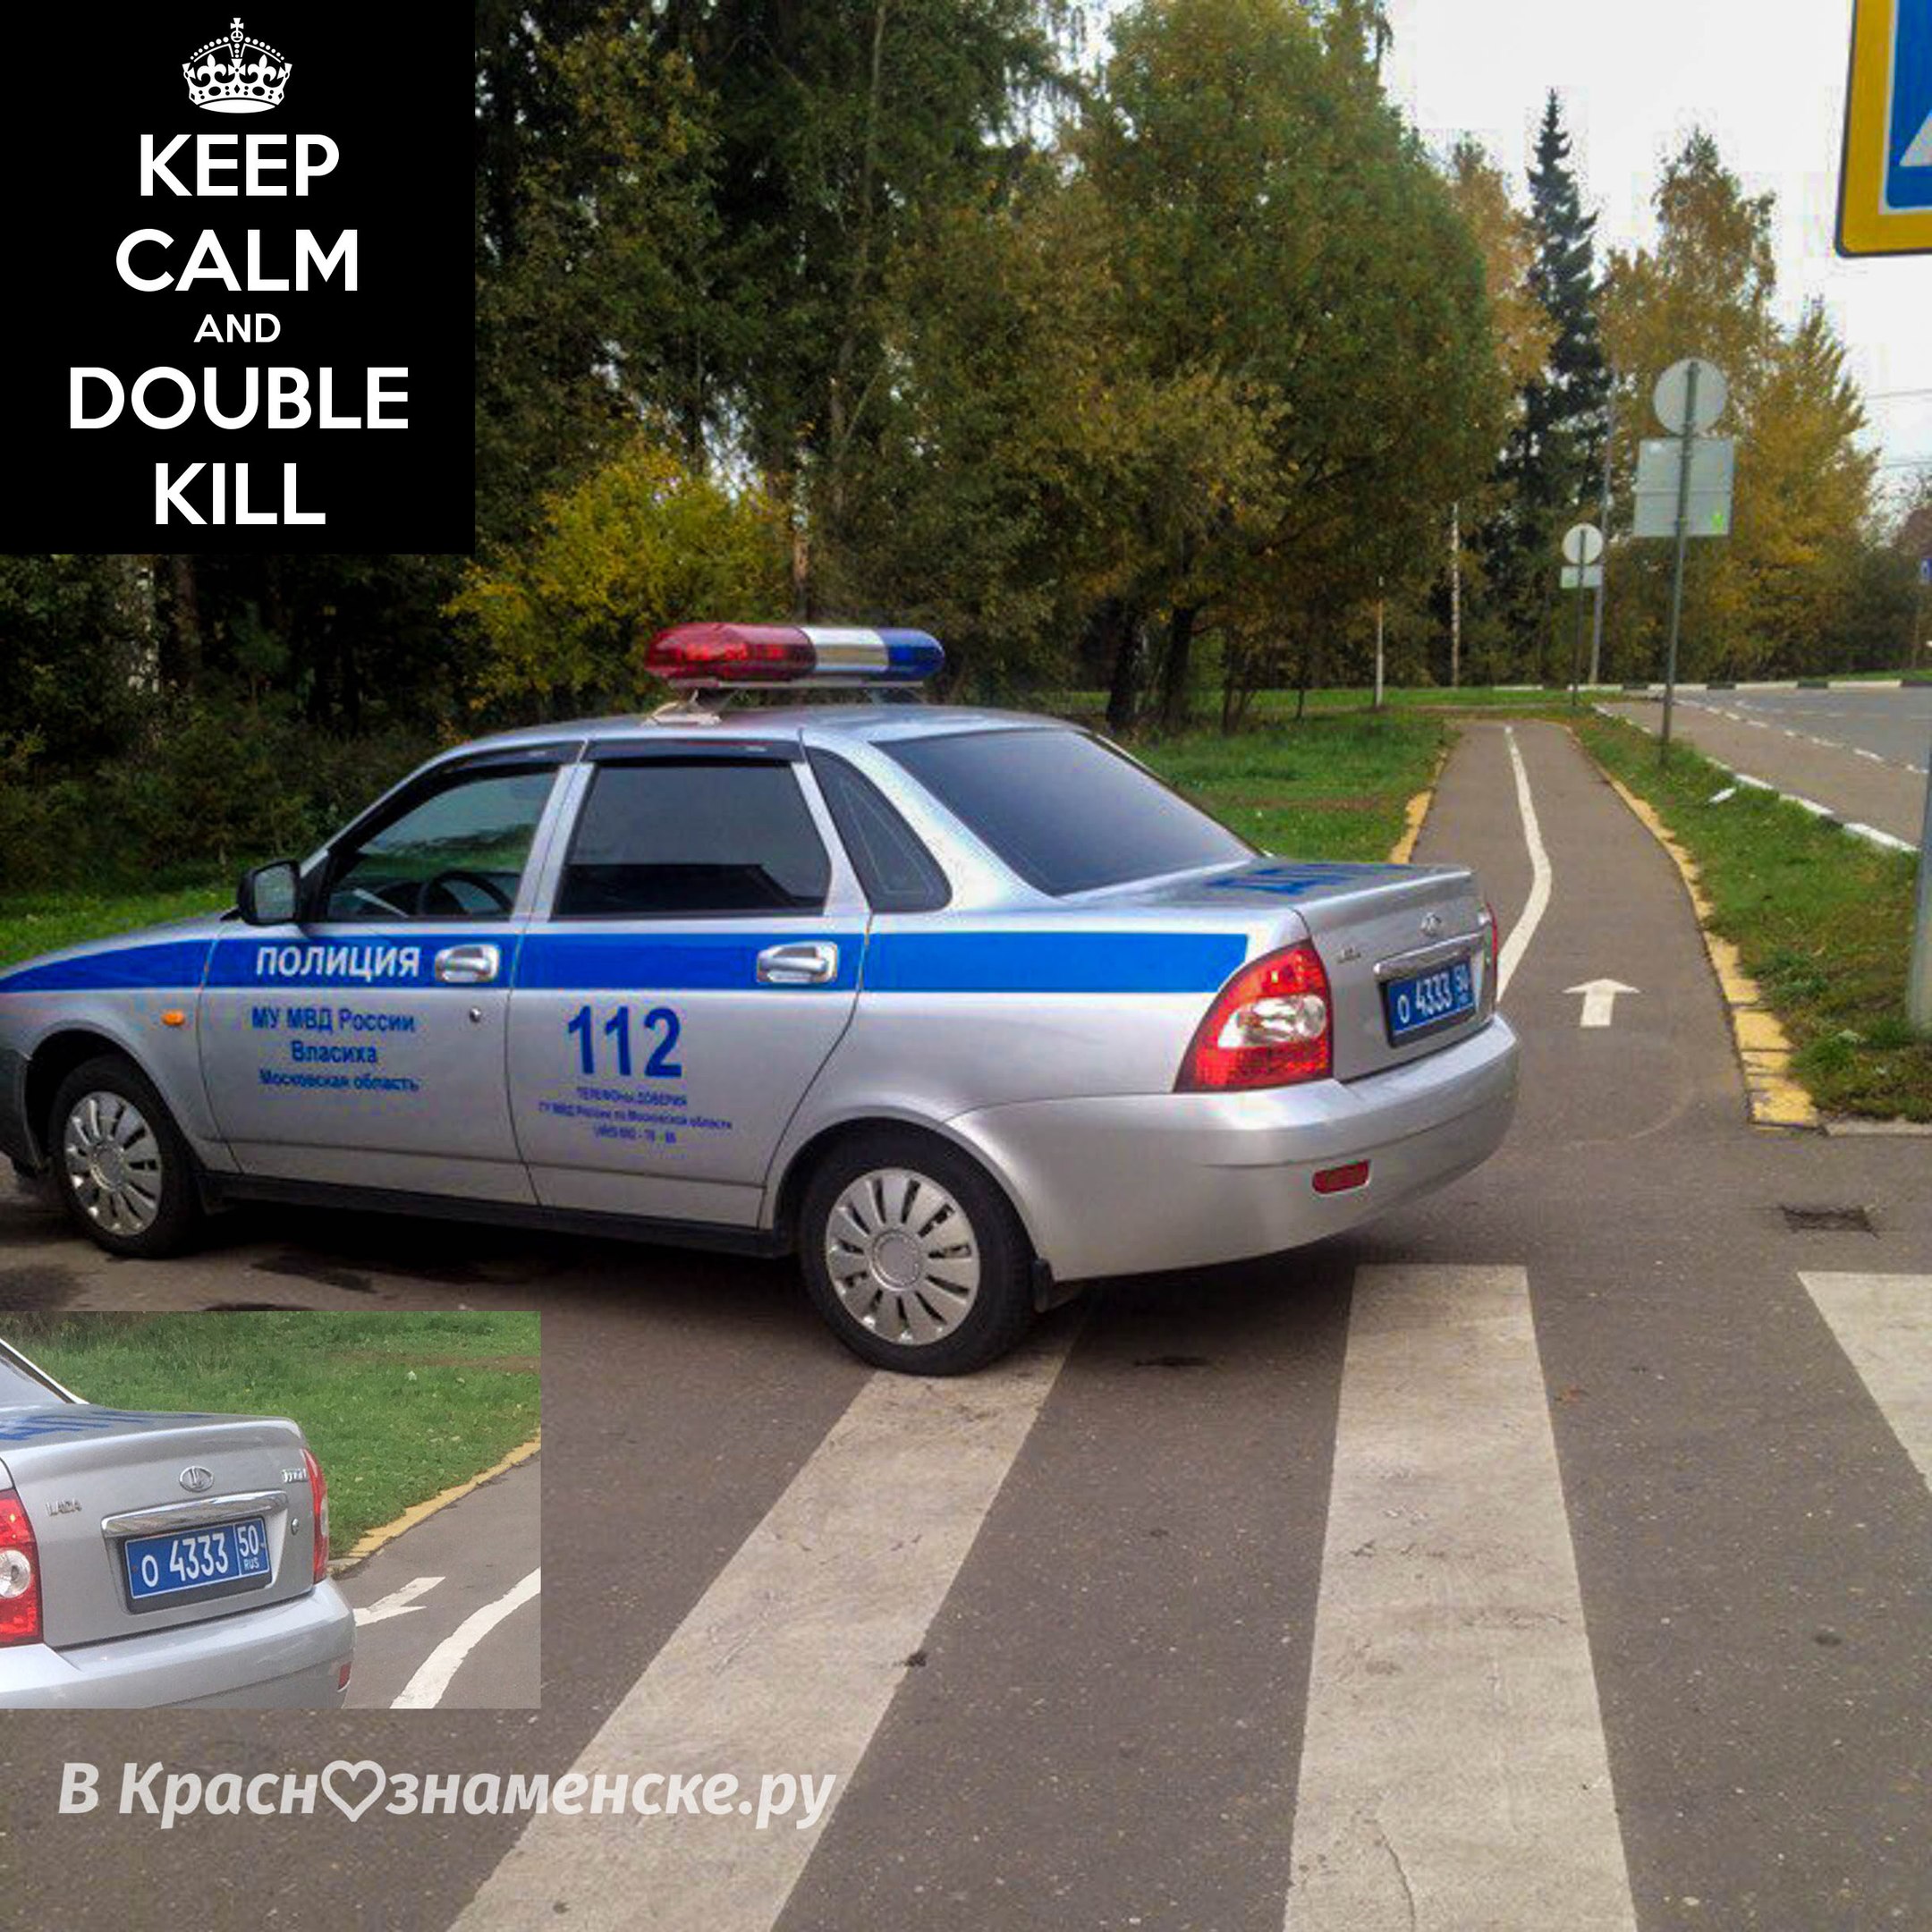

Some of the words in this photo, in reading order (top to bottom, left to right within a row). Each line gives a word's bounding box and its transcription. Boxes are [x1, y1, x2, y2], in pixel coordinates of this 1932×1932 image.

[257, 945, 420, 982] ПОЛИЦИЯ
[1416, 972, 1453, 1016] 4333
[252, 1006, 279, 1029] МУ
[286, 1007, 332, 1034] МВД
[337, 1008, 415, 1032] России
[291, 1039, 377, 1063] Власиха
[568, 1005, 682, 1077] 112
[353, 1073, 419, 1090] область
[169, 1532, 229, 1581] 4333
[237, 1524, 259, 1558] 50
[243, 1557, 260, 1571] RUS
